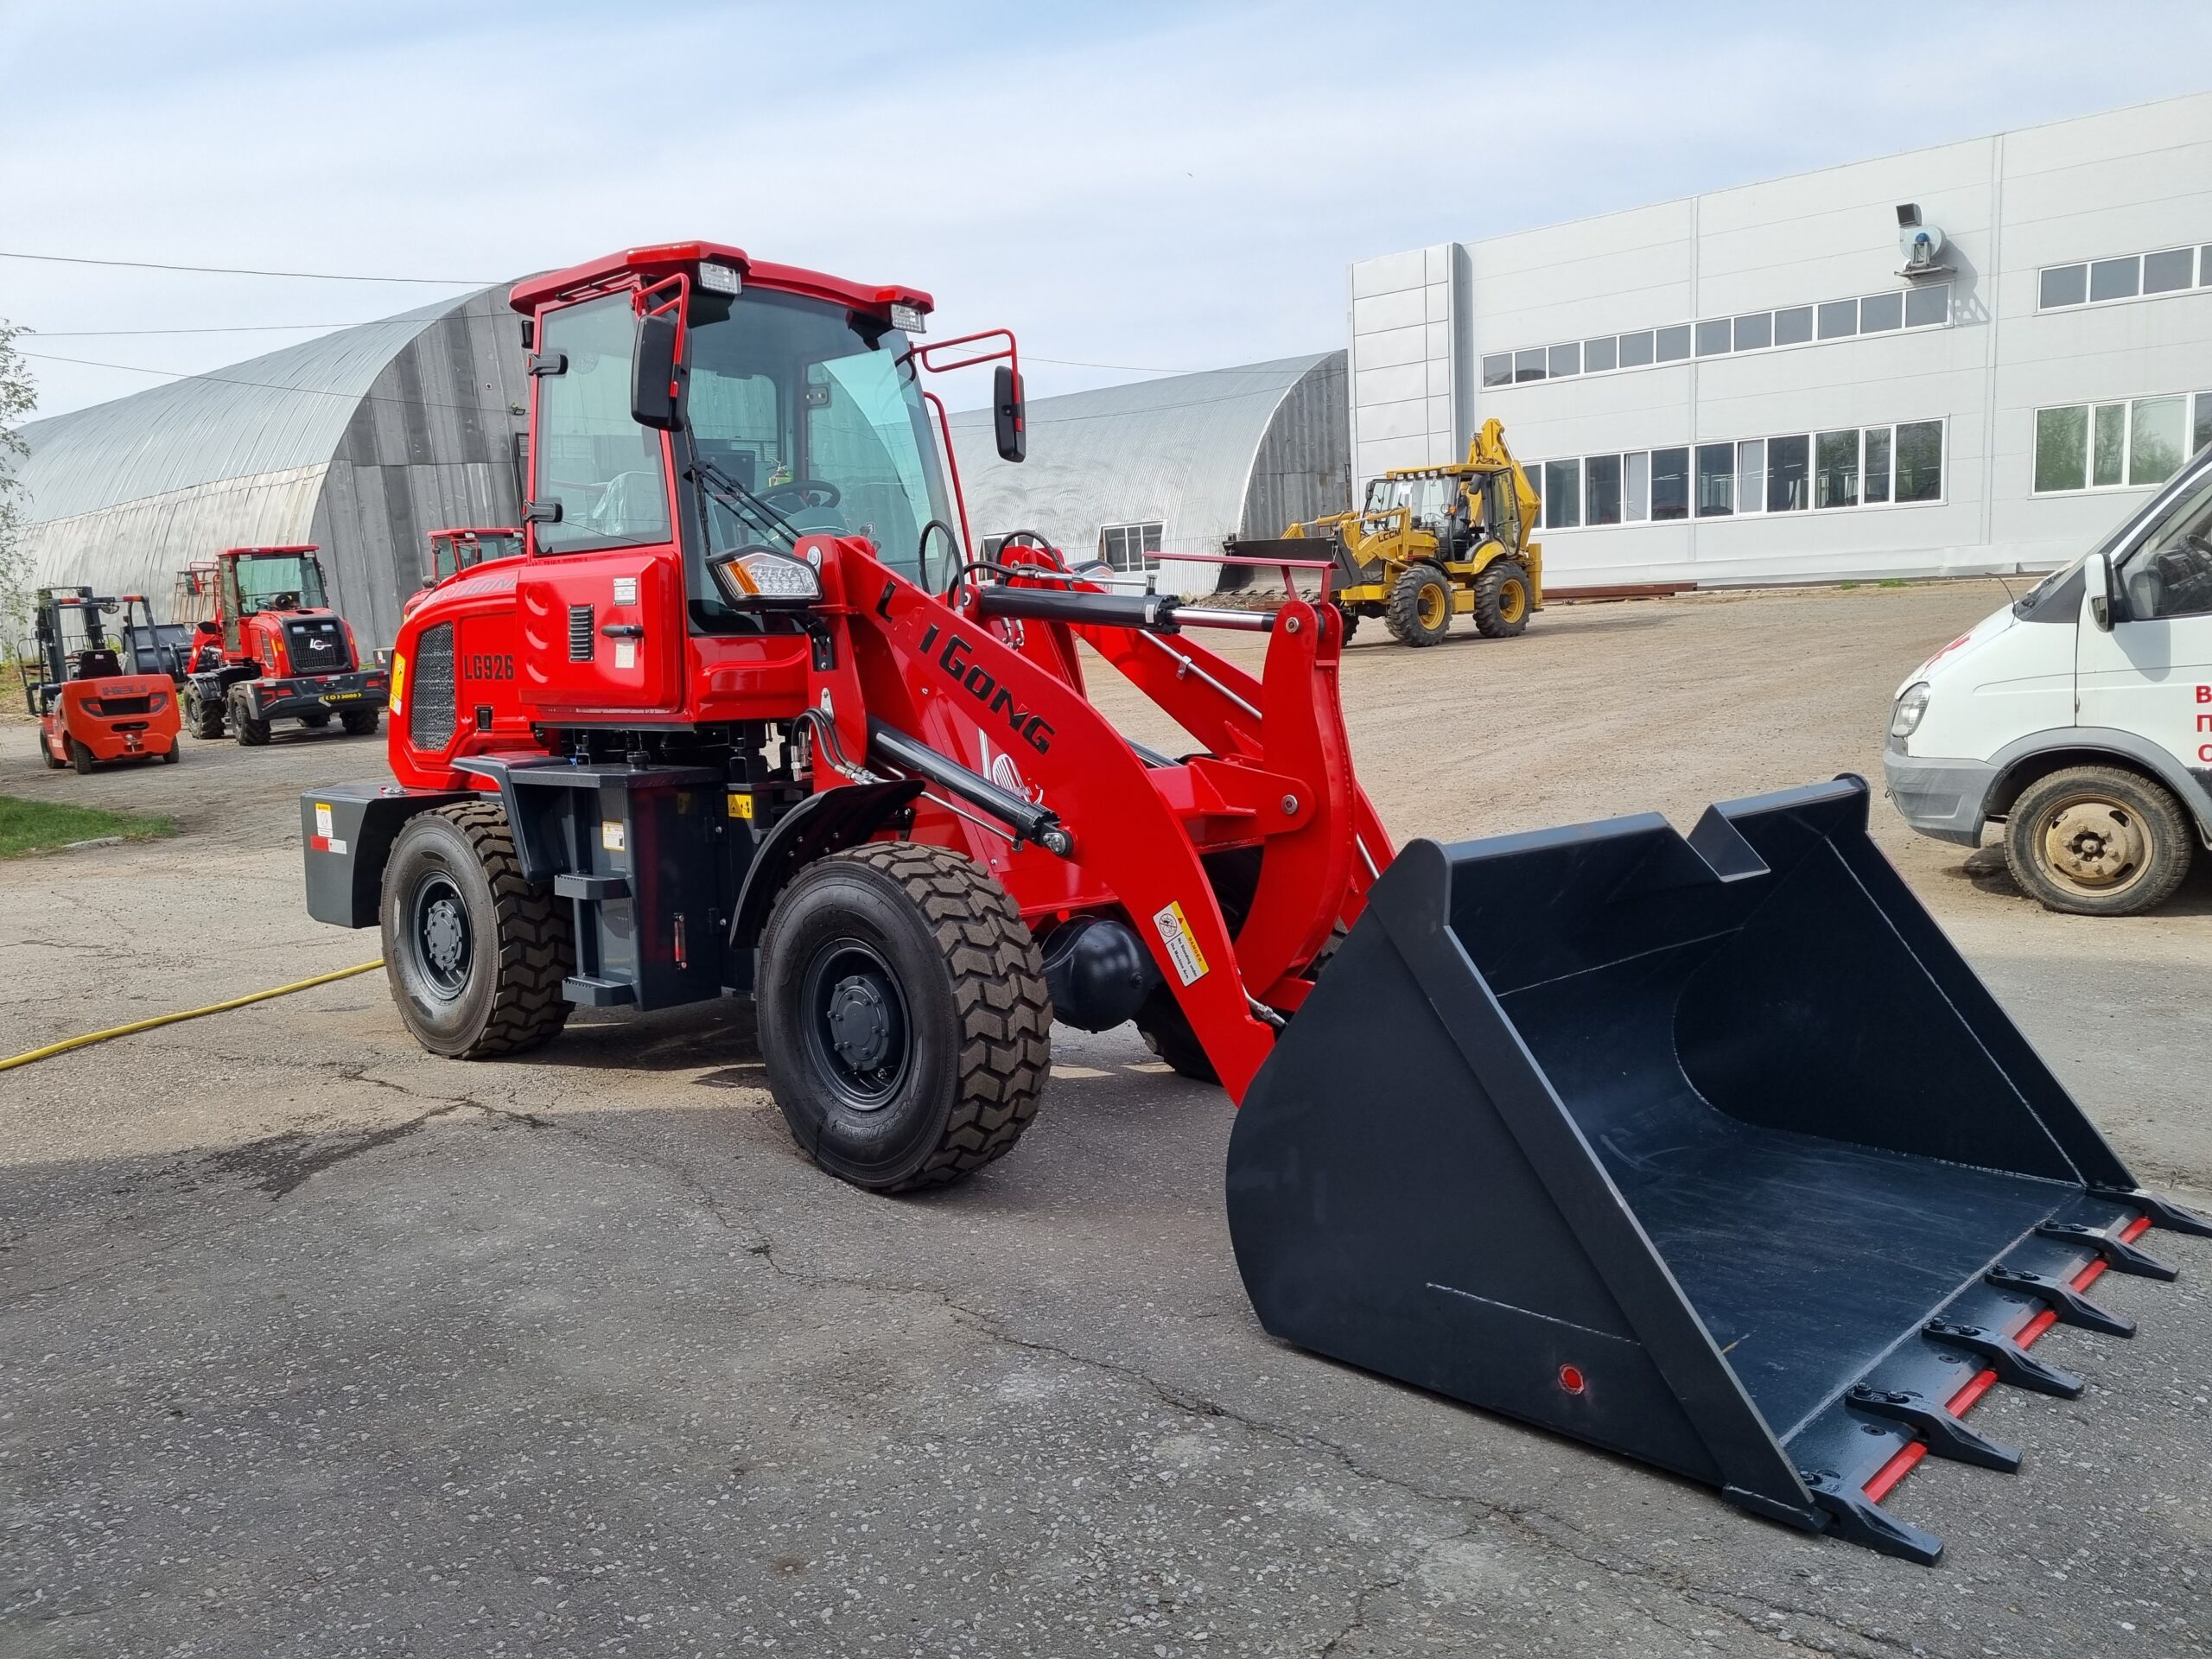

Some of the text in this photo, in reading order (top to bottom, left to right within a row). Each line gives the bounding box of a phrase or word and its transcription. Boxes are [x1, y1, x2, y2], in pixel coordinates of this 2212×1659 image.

[463, 654, 515, 681] LG926
[1174, 950, 1185, 969] Machine
[1180, 944, 1192, 965] Standing
[1188, 937, 1202, 963] DANGER
